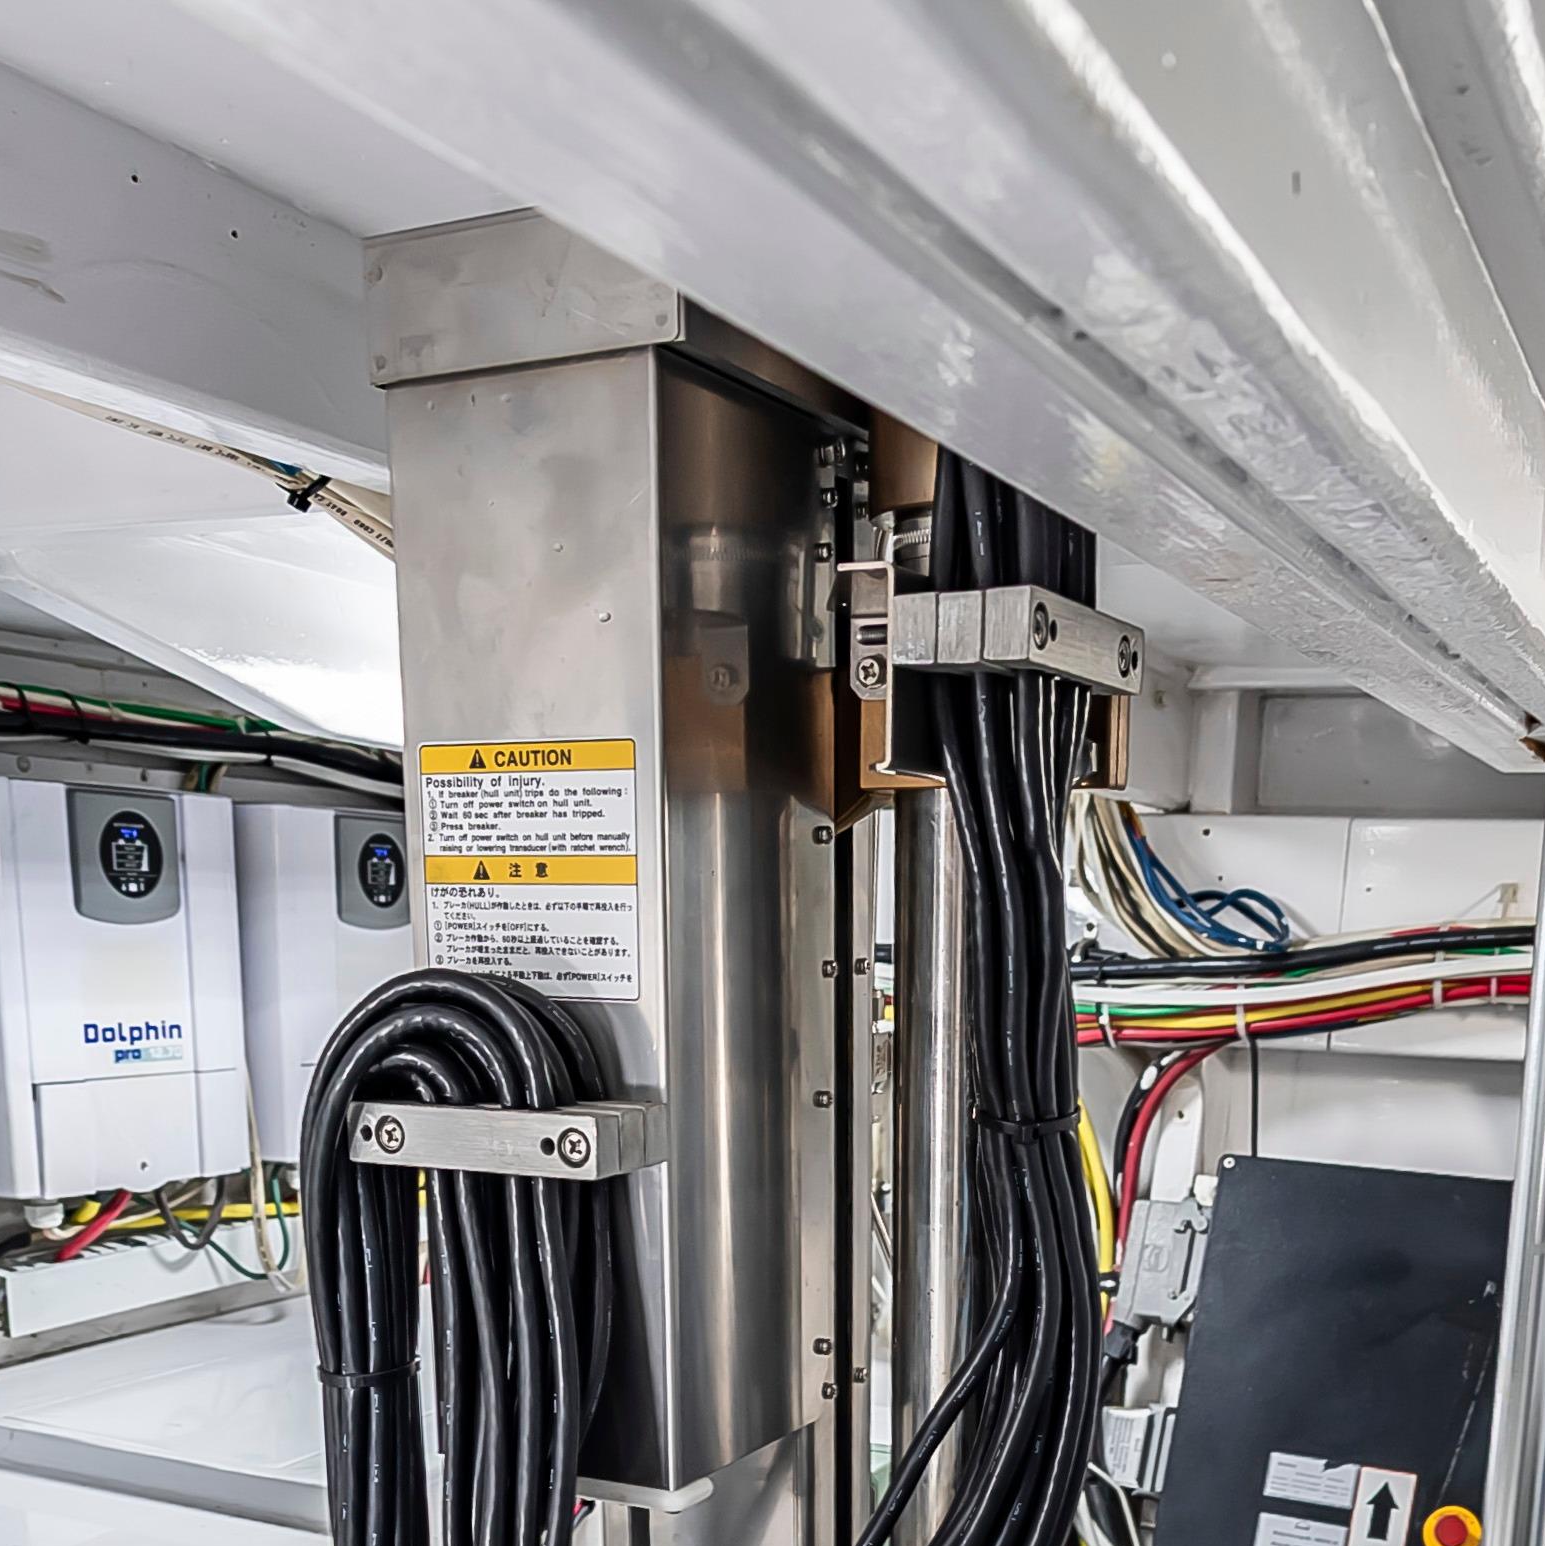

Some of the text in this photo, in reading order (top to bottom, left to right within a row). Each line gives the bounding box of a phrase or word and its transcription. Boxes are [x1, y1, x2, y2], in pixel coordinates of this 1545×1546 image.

[494, 749, 572, 768] CAUTION
[425, 775, 545, 790] Possibility of injury.
[448, 790, 478, 798] breaker
[525, 788, 544, 798] trips
[548, 788, 560, 796] do
[564, 788, 578, 796] the
[440, 801, 458, 809] Turn
[462, 800, 474, 809] off
[478, 801, 503, 810] power
[508, 799, 535, 808] switch
[552, 799, 569, 807] hull
[573, 799, 592, 807] unit.
[440, 811, 458, 819] Wait
[493, 811, 512, 819] after
[516, 810, 548, 818] breaker
[552, 810, 567, 818] has
[572, 809, 605, 819] tripped.
[441, 822, 464, 830] Press
[467, 822, 502, 830] breaker.
[439, 833, 455, 841] Turn
[458, 833, 468, 841] off
[471, 834, 493, 842] power
[496, 833, 519, 841] switch
[535, 833, 549, 841] hull
[553, 833, 566, 841] unit
[570, 833, 593, 841] before
[597, 832, 630, 842] manually
[439, 844, 463, 853] raising
[476, 844, 506, 853] lowering
[509, 844, 547, 852] transducer
[570, 844, 595, 852] ratchet
[83, 1019, 182, 1045] Dolphin
[114, 1048, 142, 1064] pro
